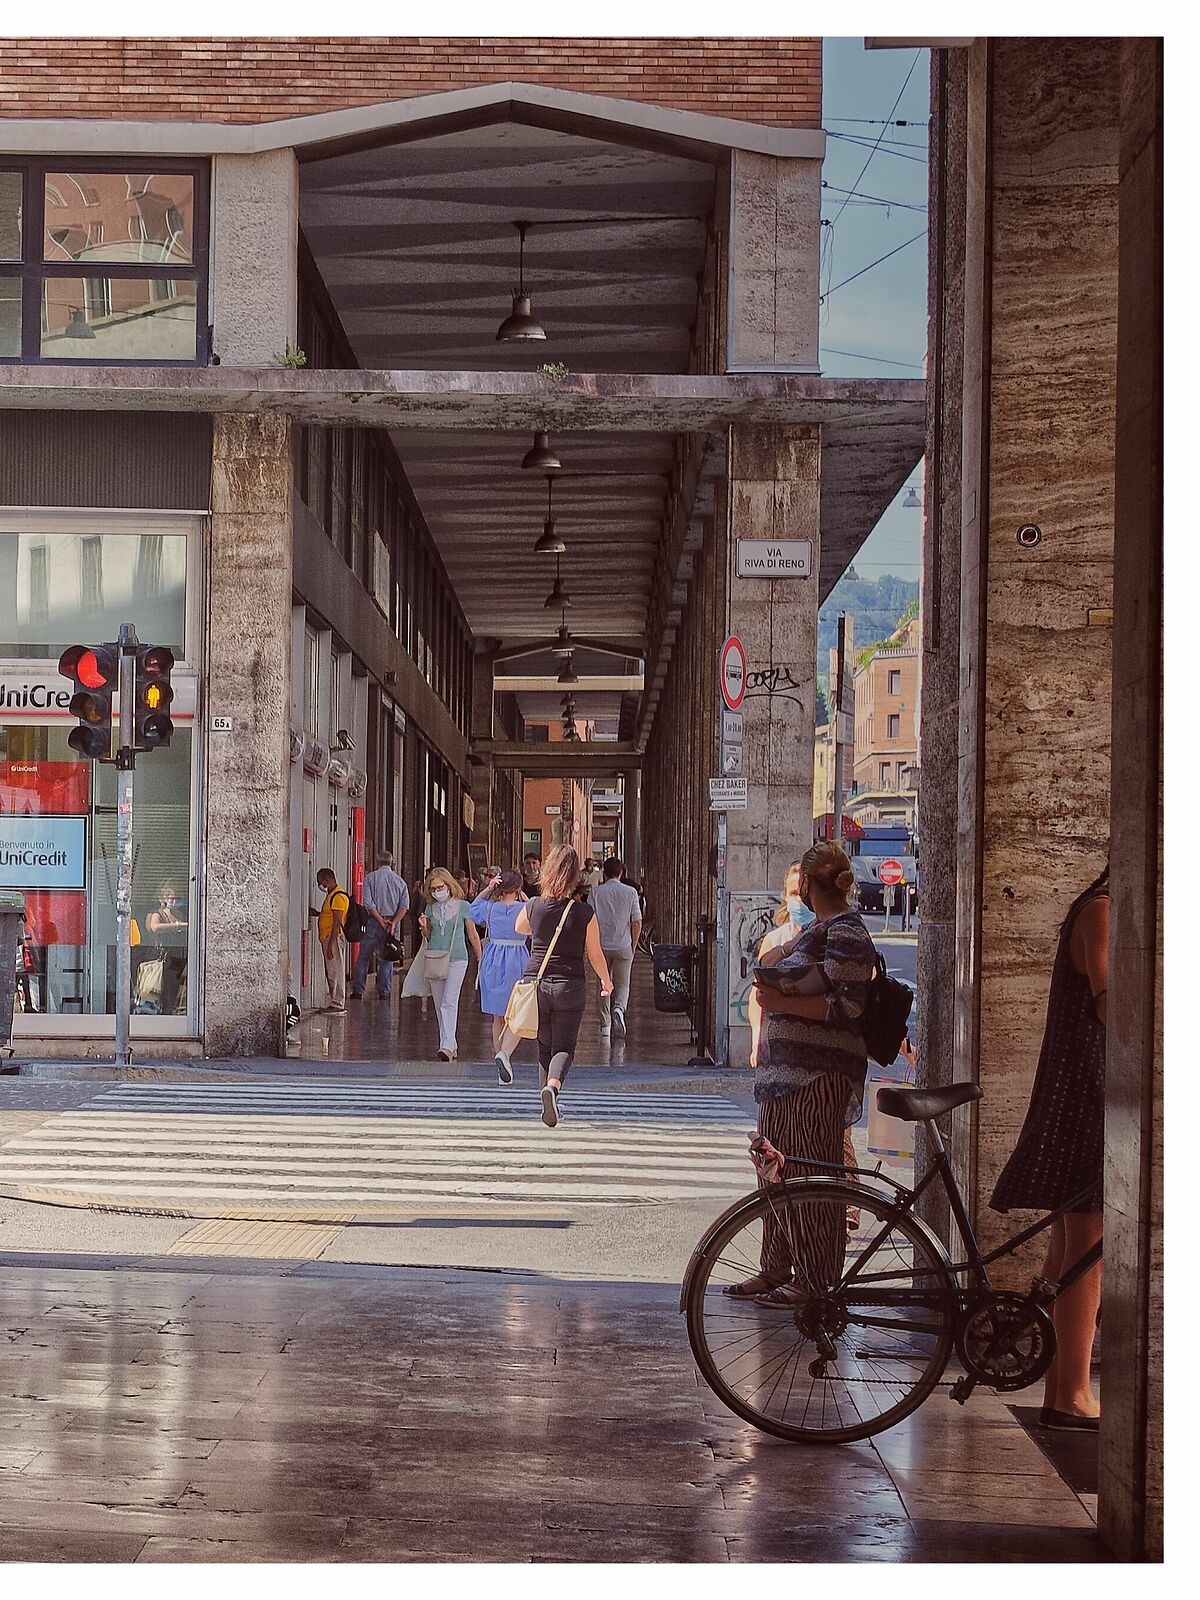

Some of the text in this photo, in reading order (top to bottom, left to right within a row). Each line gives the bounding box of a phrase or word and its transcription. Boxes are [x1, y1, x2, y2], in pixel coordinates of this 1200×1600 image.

[767, 548, 782, 557] VIA
[744, 559, 805, 568] RIVA DI RENO
[16, 765, 38, 773] UniCredit
[711, 779, 746, 790] CHEZ BAKER
[0, 840, 55, 849] Benvenuto in
